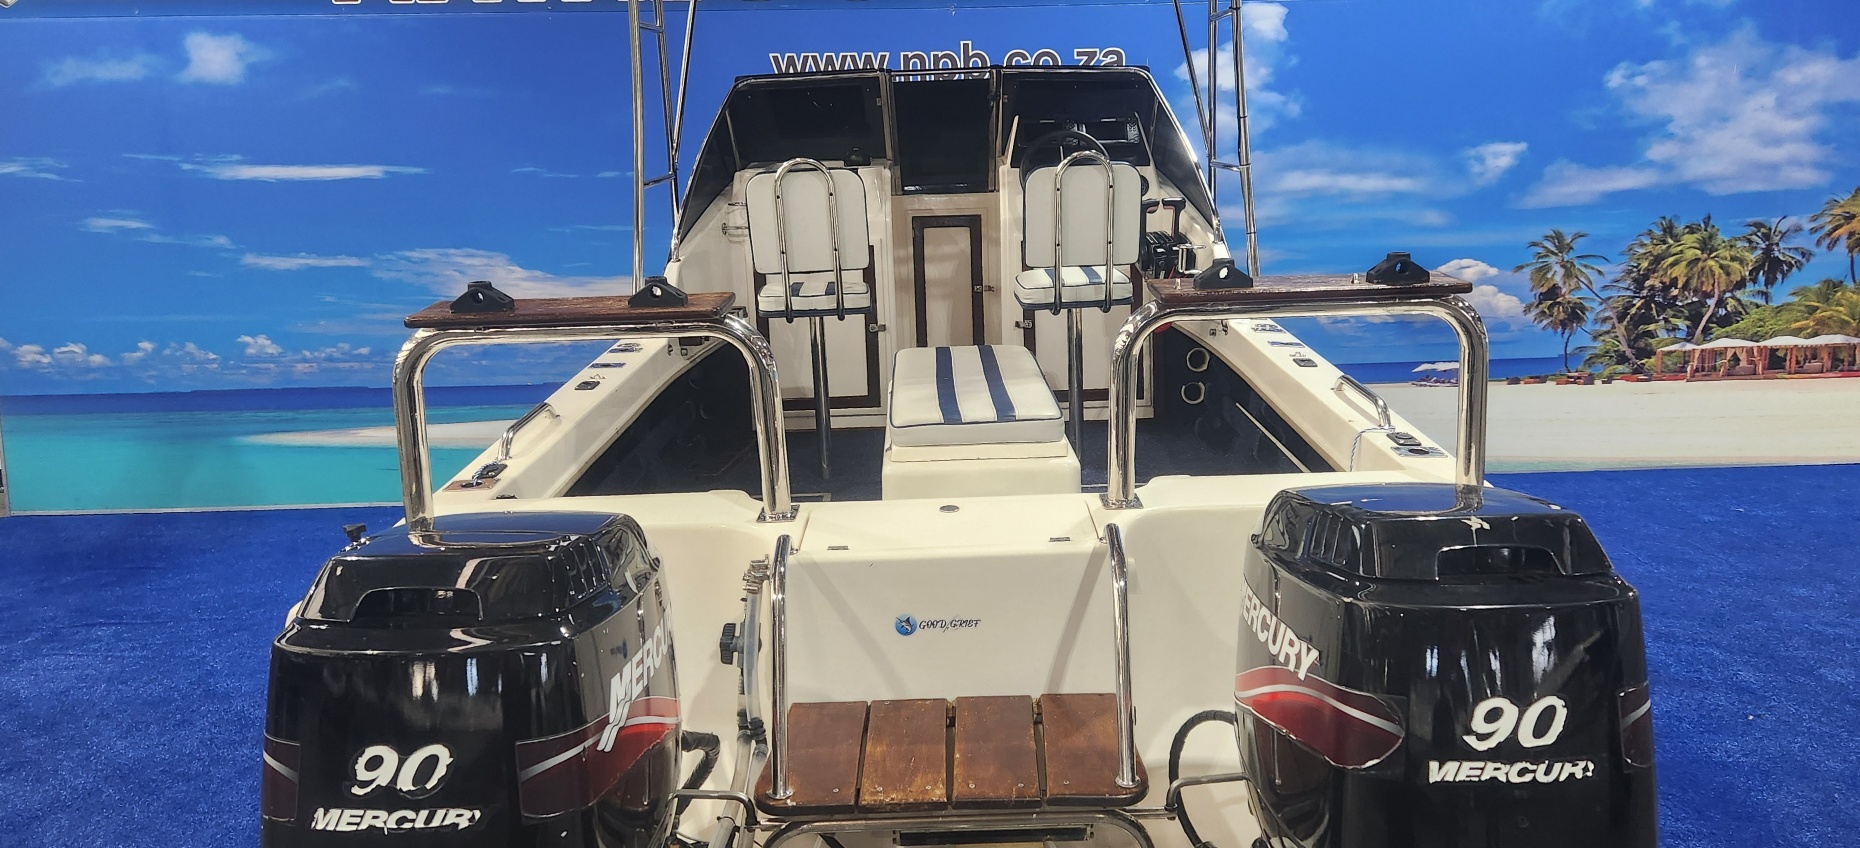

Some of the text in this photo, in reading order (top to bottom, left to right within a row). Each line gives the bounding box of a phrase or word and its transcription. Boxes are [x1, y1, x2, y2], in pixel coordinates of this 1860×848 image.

[769, 40, 1126, 82] wwwnpbcoza
[918, 615, 981, 632] GOOD GRIEF
[1242, 578, 1319, 681] ERCURY
[608, 608, 670, 725] MERCU
[1461, 695, 1568, 752] 90
[350, 743, 455, 796] 90
